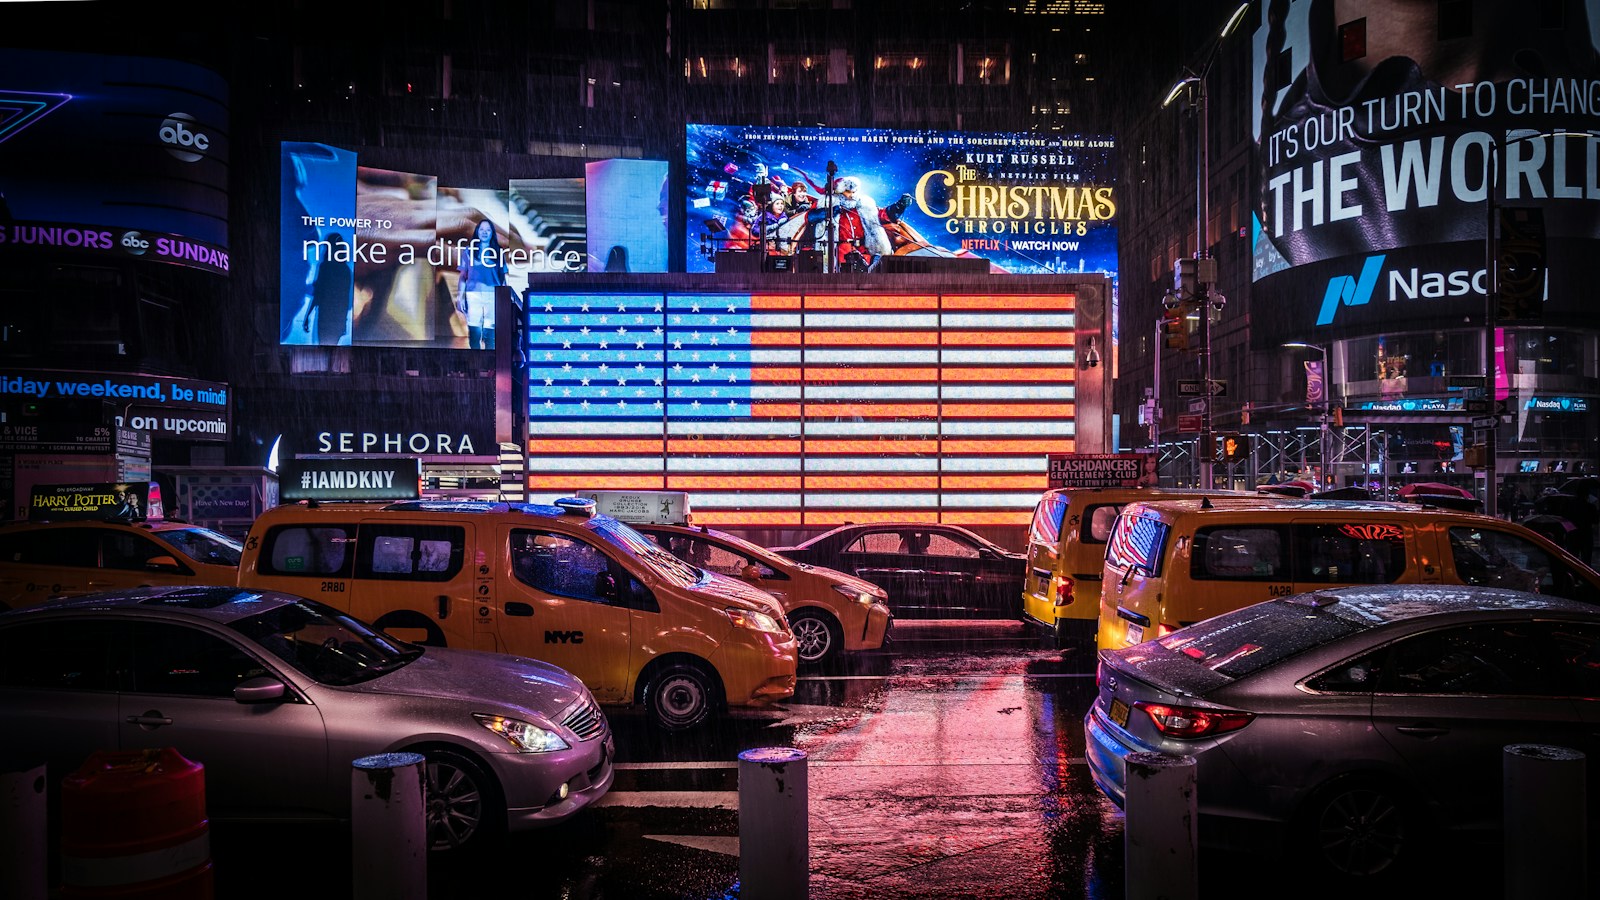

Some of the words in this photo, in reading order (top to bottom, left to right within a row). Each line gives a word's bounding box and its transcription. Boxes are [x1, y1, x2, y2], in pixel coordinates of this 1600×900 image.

[1269, 124, 1299, 167] IT'S
[1304, 106, 1355, 151] OUR
[1362, 86, 1445, 134] TURN
[1455, 80, 1496, 118] TO
[159, 122, 209, 150] abc
[862, 135, 889, 143] HARRY
[892, 136, 924, 144] POTTER
[948, 137, 964, 145] THE
[967, 137, 1017, 146] SORCERER'S
[1020, 138, 1046, 147] STONE
[1062, 139, 1085, 148] HOME
[1087, 140, 1115, 148] ALONE
[966, 153, 1004, 164] KURT
[1011, 154, 1075, 165] RUSSELL
[915, 170, 1116, 220] CHRISTMAS
[1269, 150, 1363, 238] THE
[301, 216, 325, 227] THE
[329, 217, 371, 229] POWER
[376, 219, 392, 230] TO
[946, 218, 1087, 236] CHRONICLES
[11, 225, 113, 249] JUNIORS
[121, 236, 150, 249] abc
[961, 239, 1000, 251] NETFLIX
[1011, 240, 1051, 251] WATCH
[1052, 241, 1080, 251] NOW
[155, 237, 229, 271] SUNDAYS
[303, 235, 387, 263] make
[399, 243, 415, 265] a
[427, 238, 581, 271] difference
[55, 380, 166, 402] weekend,
[171, 383, 194, 401] be
[1372, 401, 1402, 411] Nasdaq
[1536, 400, 1561, 410] Nasdaq
[14, 426, 38, 435] VICE
[94, 428, 110, 436] 5%
[131, 416, 158, 430] on
[164, 417, 227, 435] upcomin
[318, 432, 475, 454] SEPHORA
[1051, 459, 1138, 471] FLASHDANCERS
[301, 471, 395, 489] #IAMDKNY
[1051, 471, 1112, 479] GENTLEMEN'S
[1115, 470, 1137, 479] CLUB
[33, 494, 71, 507] HARRY
[74, 493, 117, 506] POTTER
[235, 500, 250, 508] Day!
[321, 581, 345, 593] 2R80
[544, 631, 584, 644] NYC
